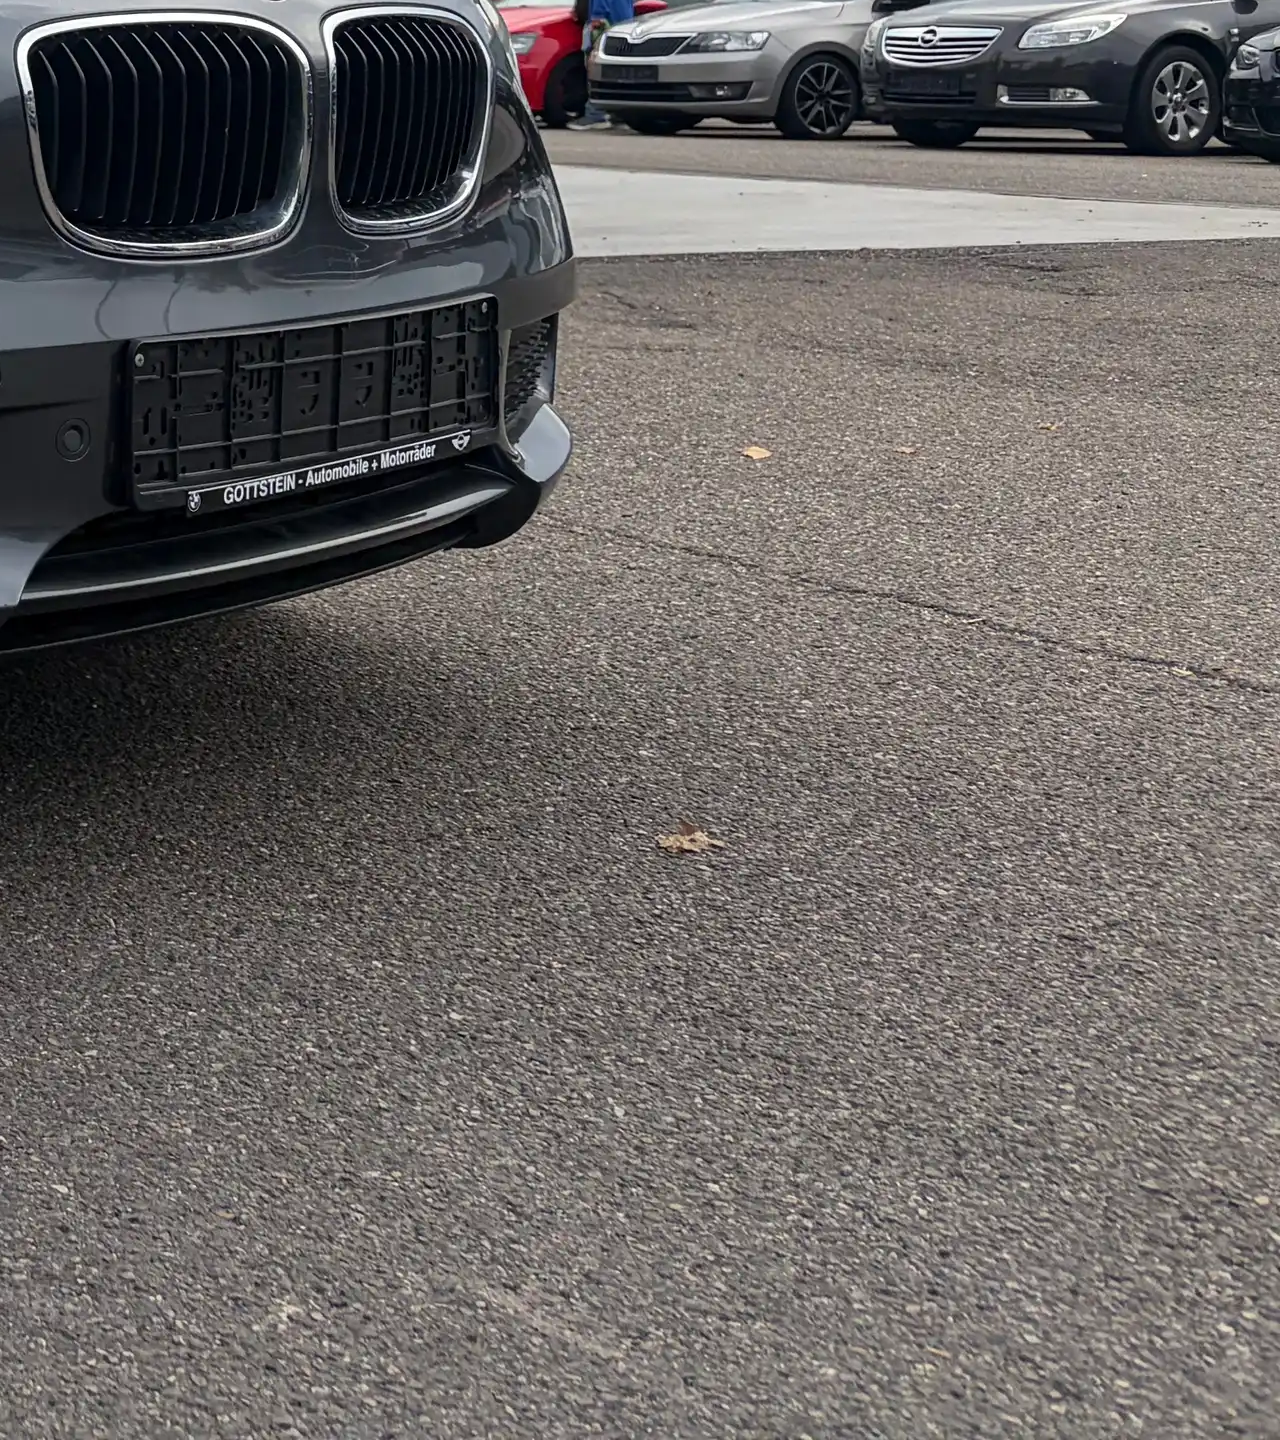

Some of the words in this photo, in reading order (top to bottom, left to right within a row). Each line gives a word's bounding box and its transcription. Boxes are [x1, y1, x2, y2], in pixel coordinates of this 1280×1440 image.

[223, 474, 296, 506] GOTTSTEIN
[306, 458, 369, 487] Automobile
[380, 443, 436, 470] Motorräder
